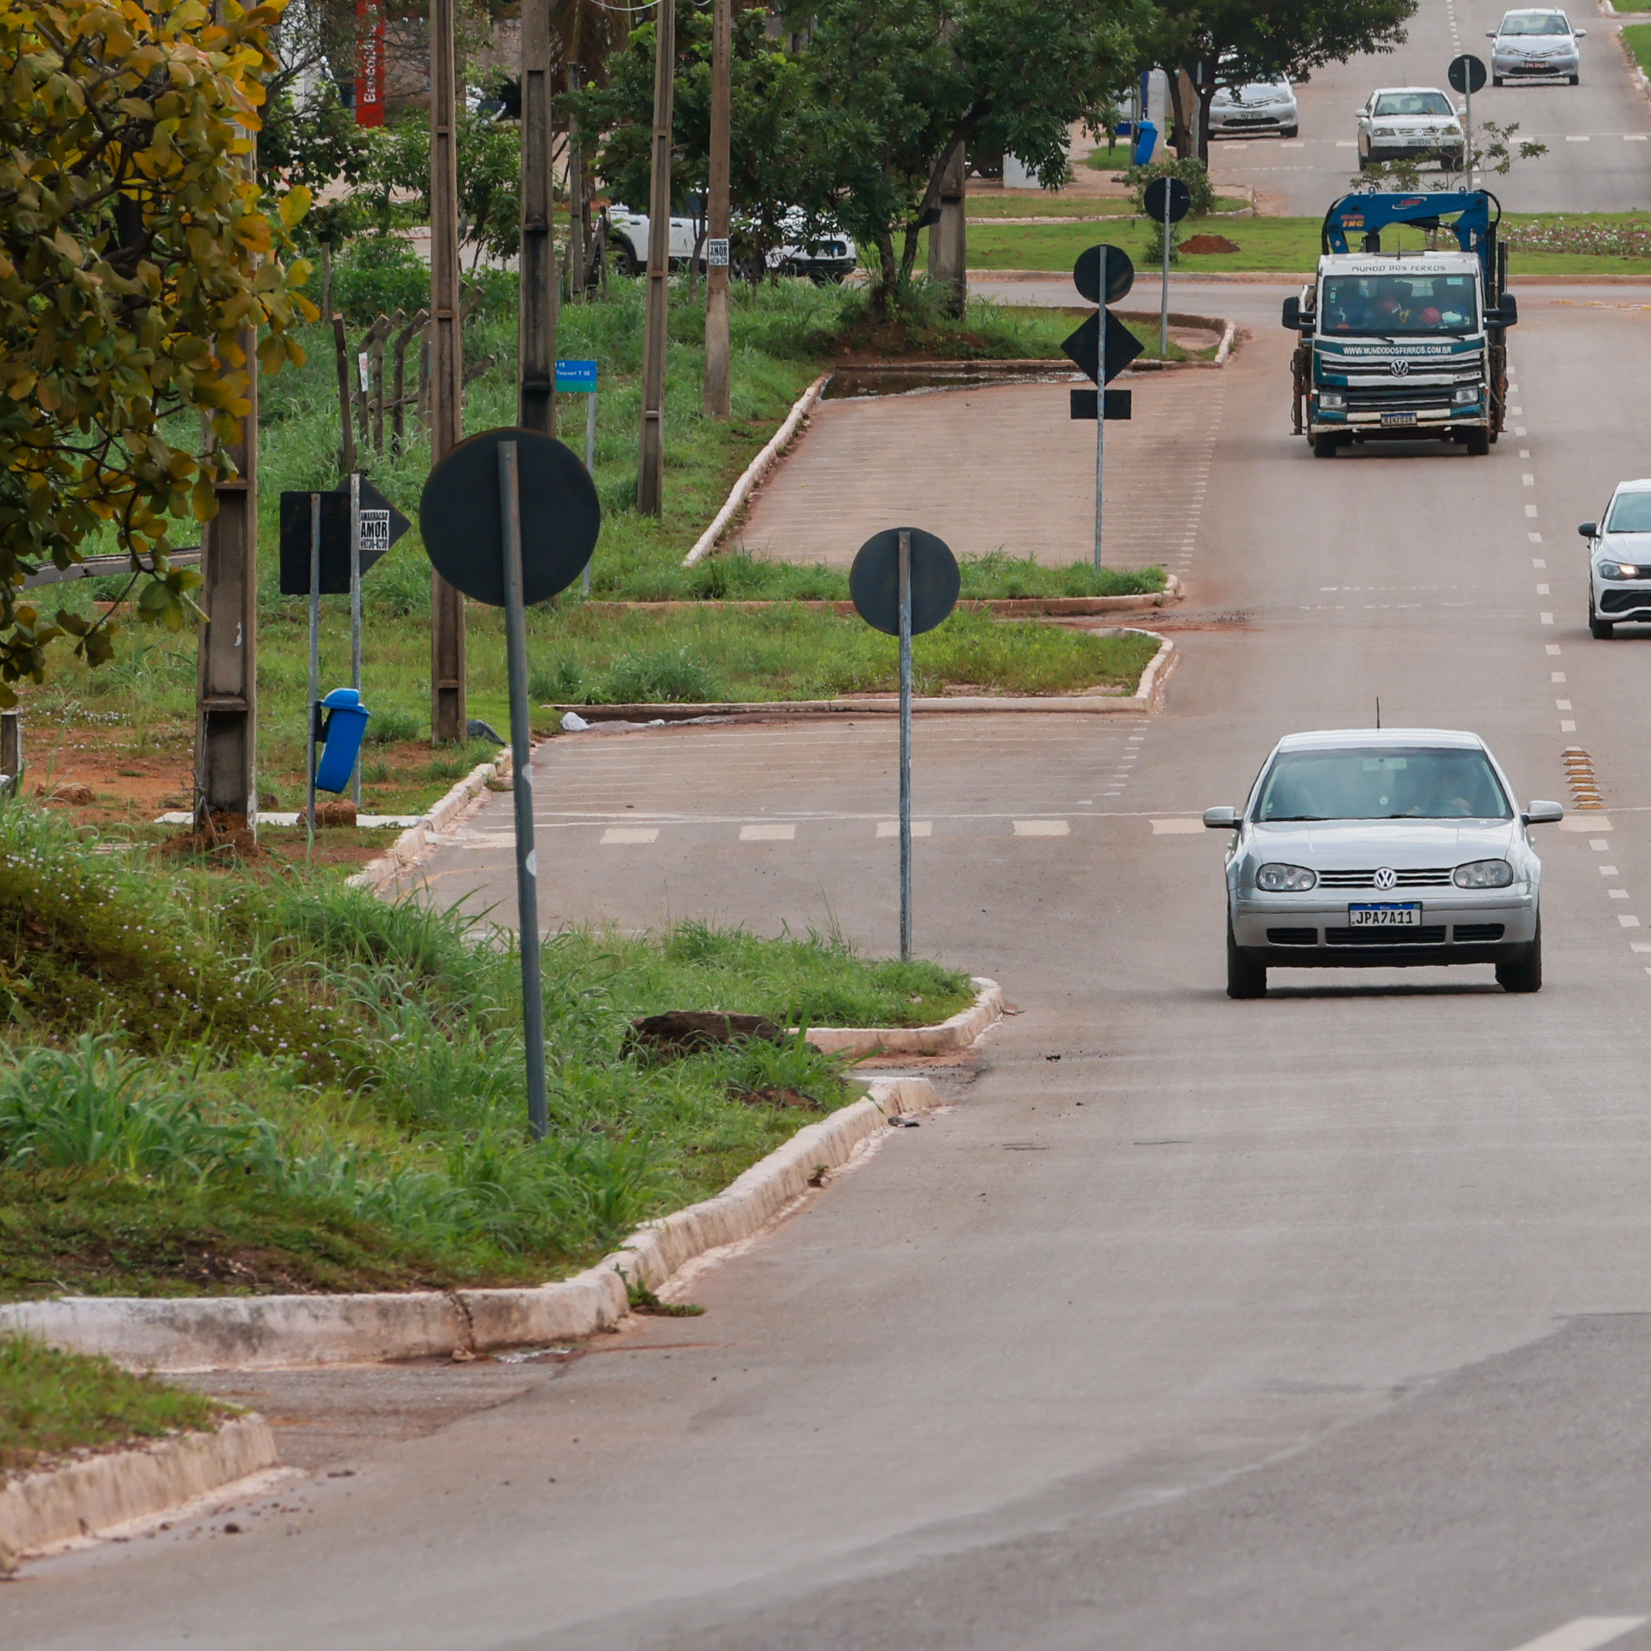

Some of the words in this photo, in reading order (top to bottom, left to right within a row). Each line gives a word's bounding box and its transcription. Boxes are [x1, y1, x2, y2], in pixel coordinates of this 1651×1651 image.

[1352, 265, 1386, 273] MUNDO
[1343, 345, 1452, 355] WWW.MUNDODOSFERROS.COM.BR
[361, 521, 388, 538] AMOR
[1356, 911, 1413, 925] JPA7A11
